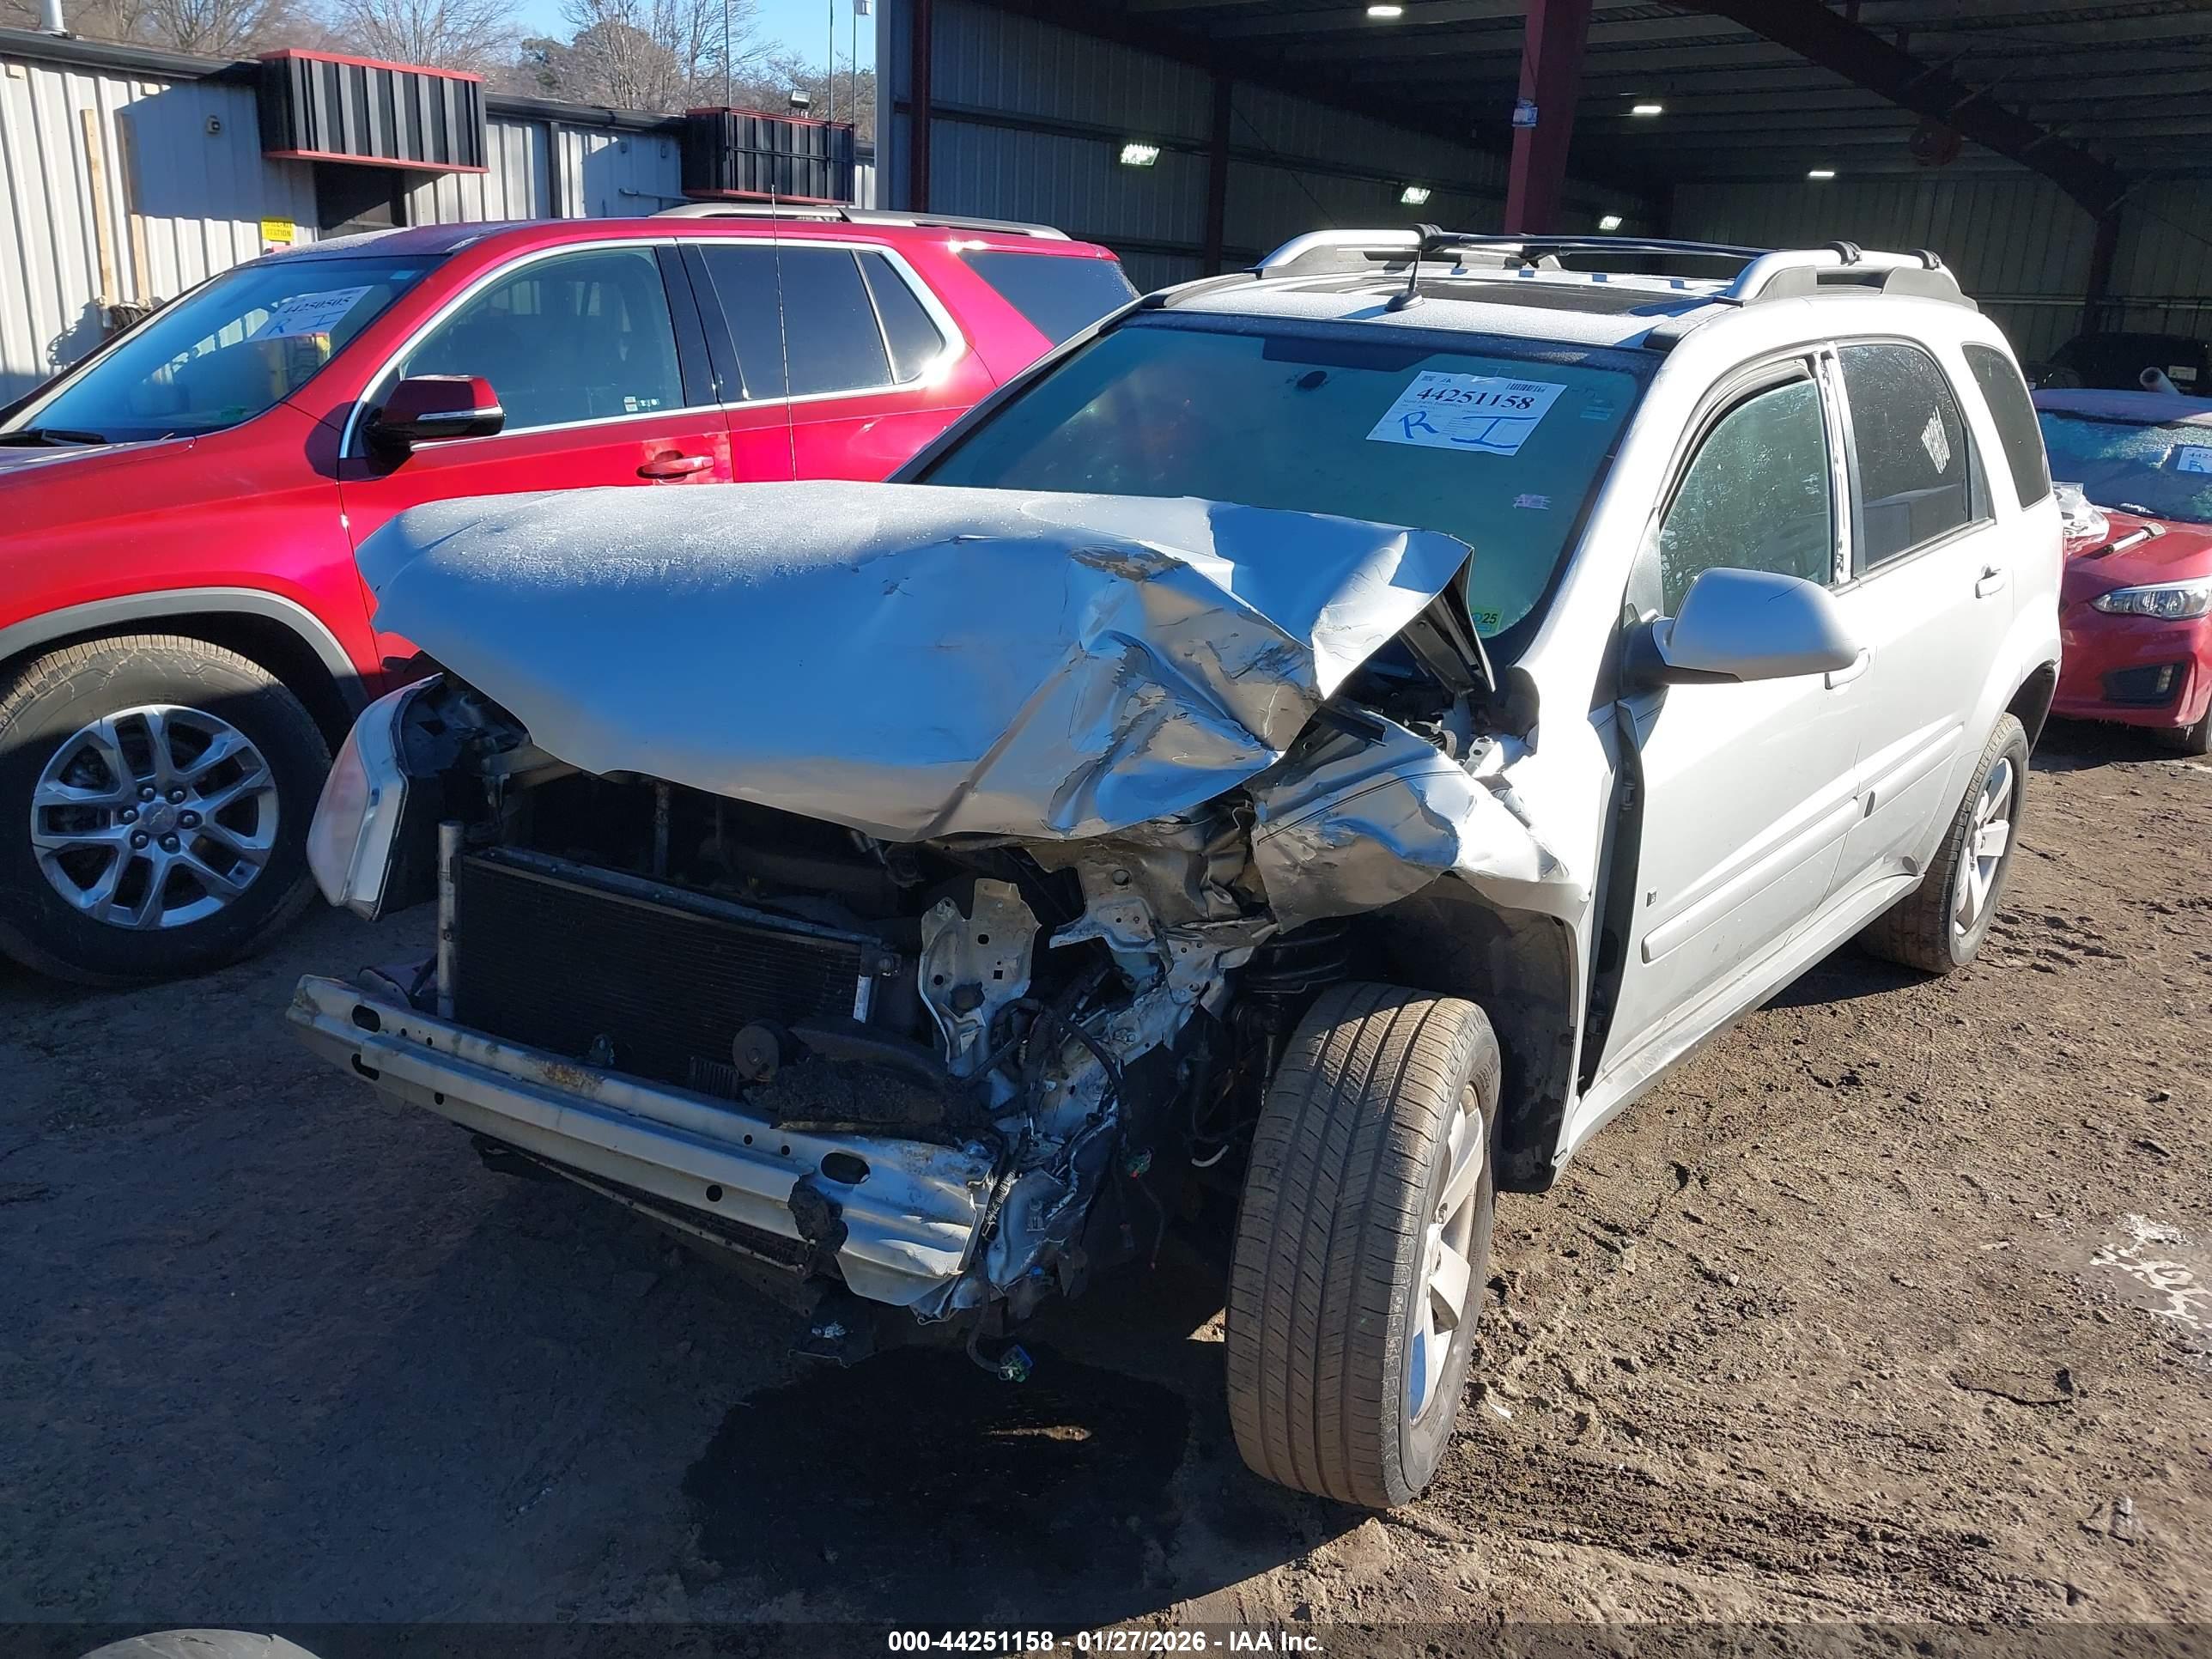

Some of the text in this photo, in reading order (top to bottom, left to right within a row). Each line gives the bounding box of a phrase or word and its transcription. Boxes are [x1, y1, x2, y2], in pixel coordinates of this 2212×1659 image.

[1416, 387, 1535, 410] 44251158
[1397, 410, 1440, 440] R
[1481, 612, 1498, 624] 25
